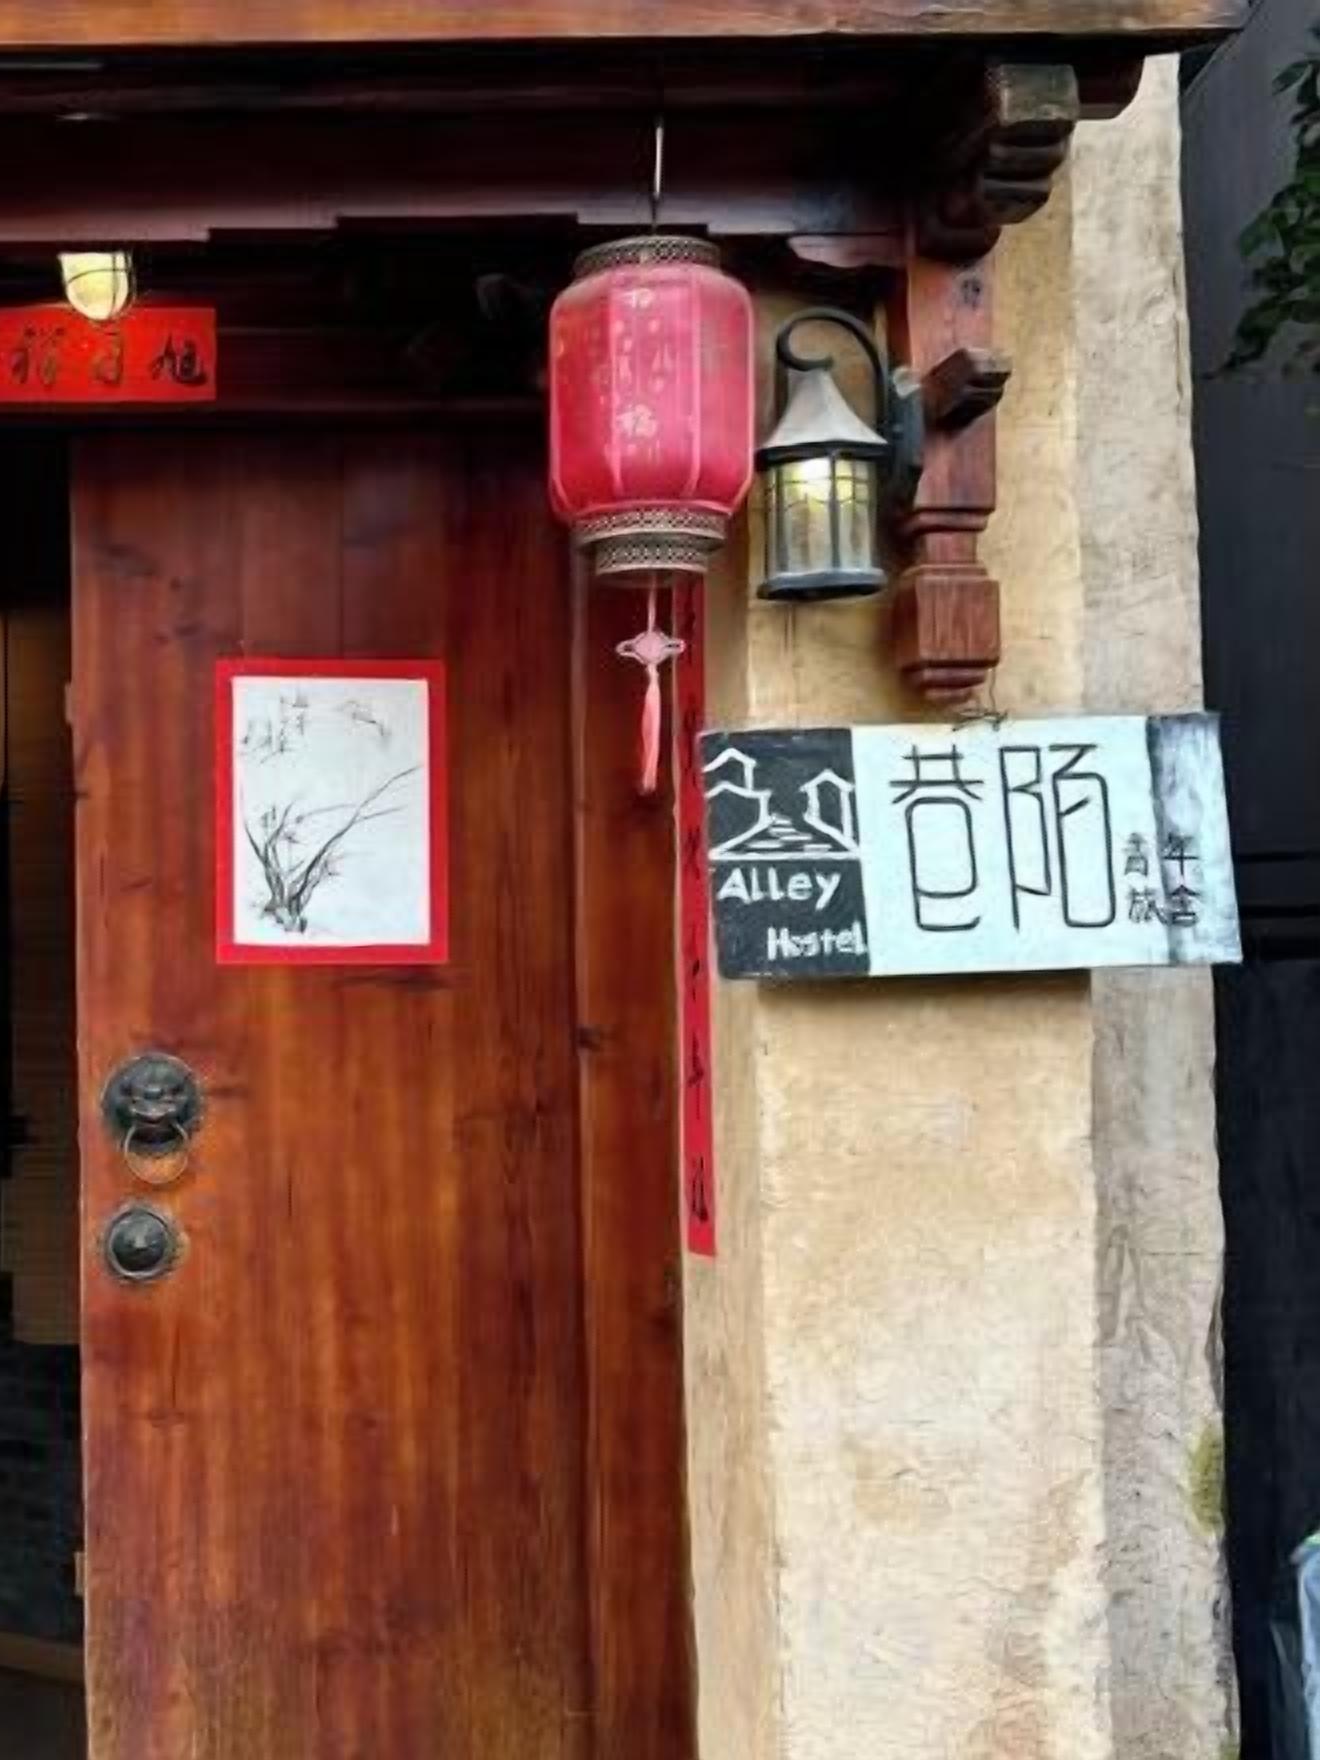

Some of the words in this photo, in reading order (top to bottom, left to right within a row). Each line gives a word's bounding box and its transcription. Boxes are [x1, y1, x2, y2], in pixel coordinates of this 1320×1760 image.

[889, 743, 1117, 933] 巷陌
[717, 867, 841, 911] Alley
[767, 920, 867, 960] Hostel
